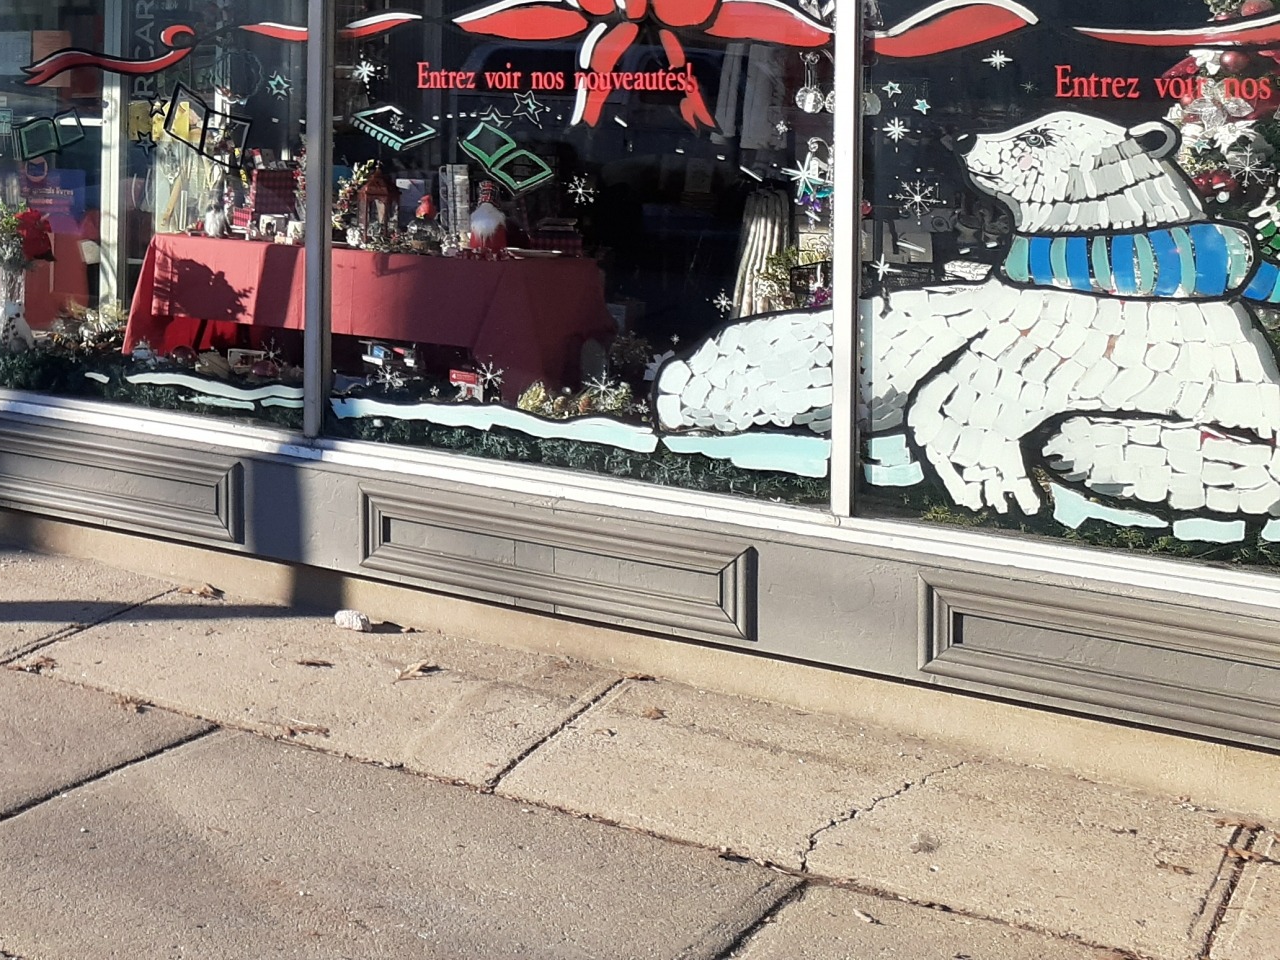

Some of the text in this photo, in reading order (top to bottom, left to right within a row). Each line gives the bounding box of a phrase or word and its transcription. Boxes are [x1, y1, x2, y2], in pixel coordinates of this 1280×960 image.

[416, 61, 698, 93] Entrez voir nos nouveautés!
[1054, 64, 1272, 100] Entrez voir nos
